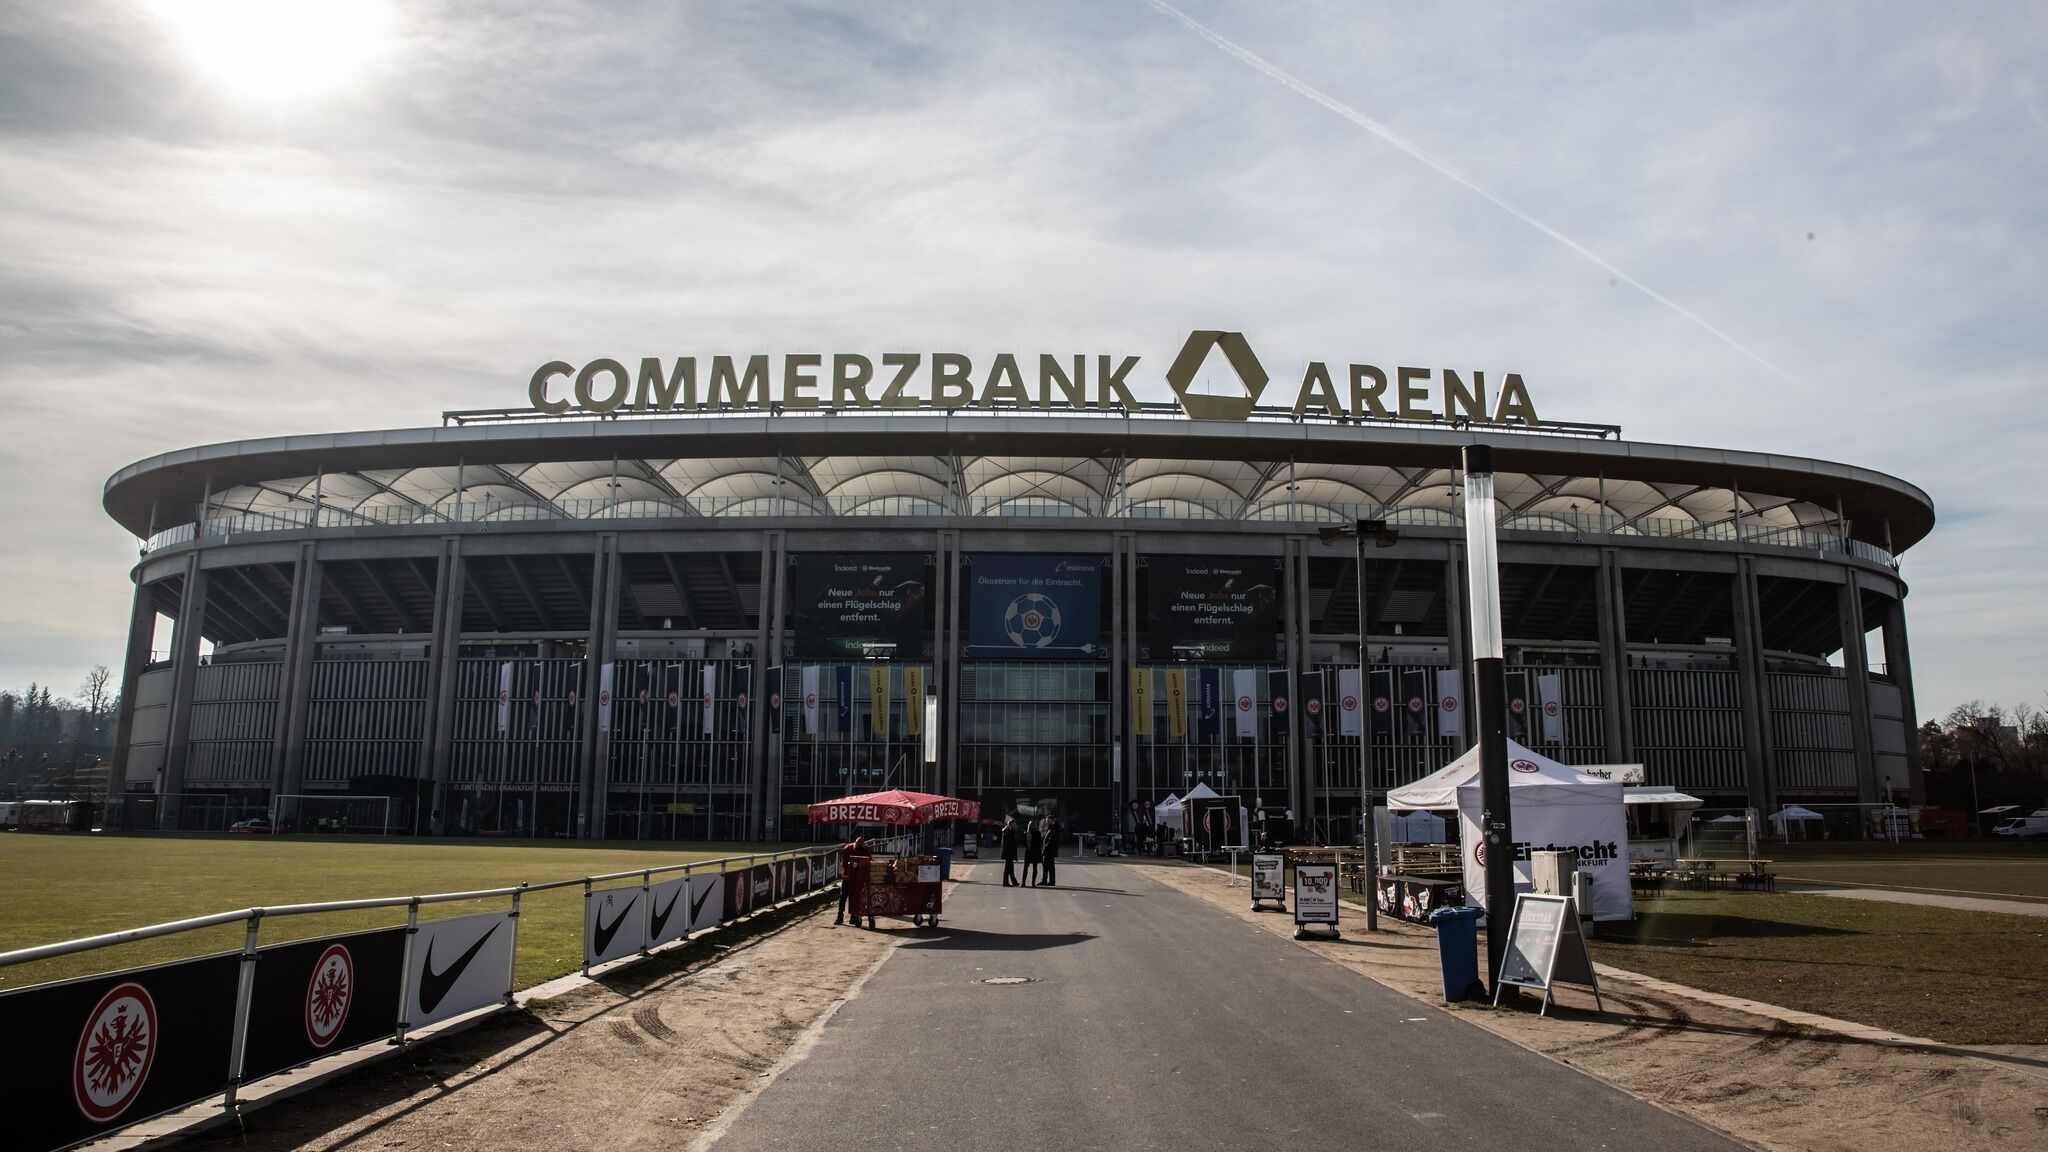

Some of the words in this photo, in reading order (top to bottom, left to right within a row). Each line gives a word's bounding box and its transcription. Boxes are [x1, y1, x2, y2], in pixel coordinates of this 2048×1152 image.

[528, 352, 1141, 416] COMMERZBANK
[1291, 361, 1539, 426] ARENA
[978, 575, 1017, 585] Ökostrom
[1019, 576, 1029, 585] für
[1031, 577, 1044, 586] die
[1045, 577, 1083, 587] Eintracht.
[828, 587, 854, 597] Neue
[879, 588, 895, 597] nur
[1181, 591, 1206, 600] Neue
[1231, 592, 1246, 600] nur
[818, 600, 843, 609] einen
[845, 599, 902, 612] Flügelschlag
[1171, 603, 1196, 612] einen
[1198, 603, 1254, 615] Flügelschlag
[840, 611, 880, 622] entfernt.
[1194, 615, 1234, 625] entfernt.
[829, 804, 880, 821] BREZEL
[934, 801, 959, 818] BREZEL
